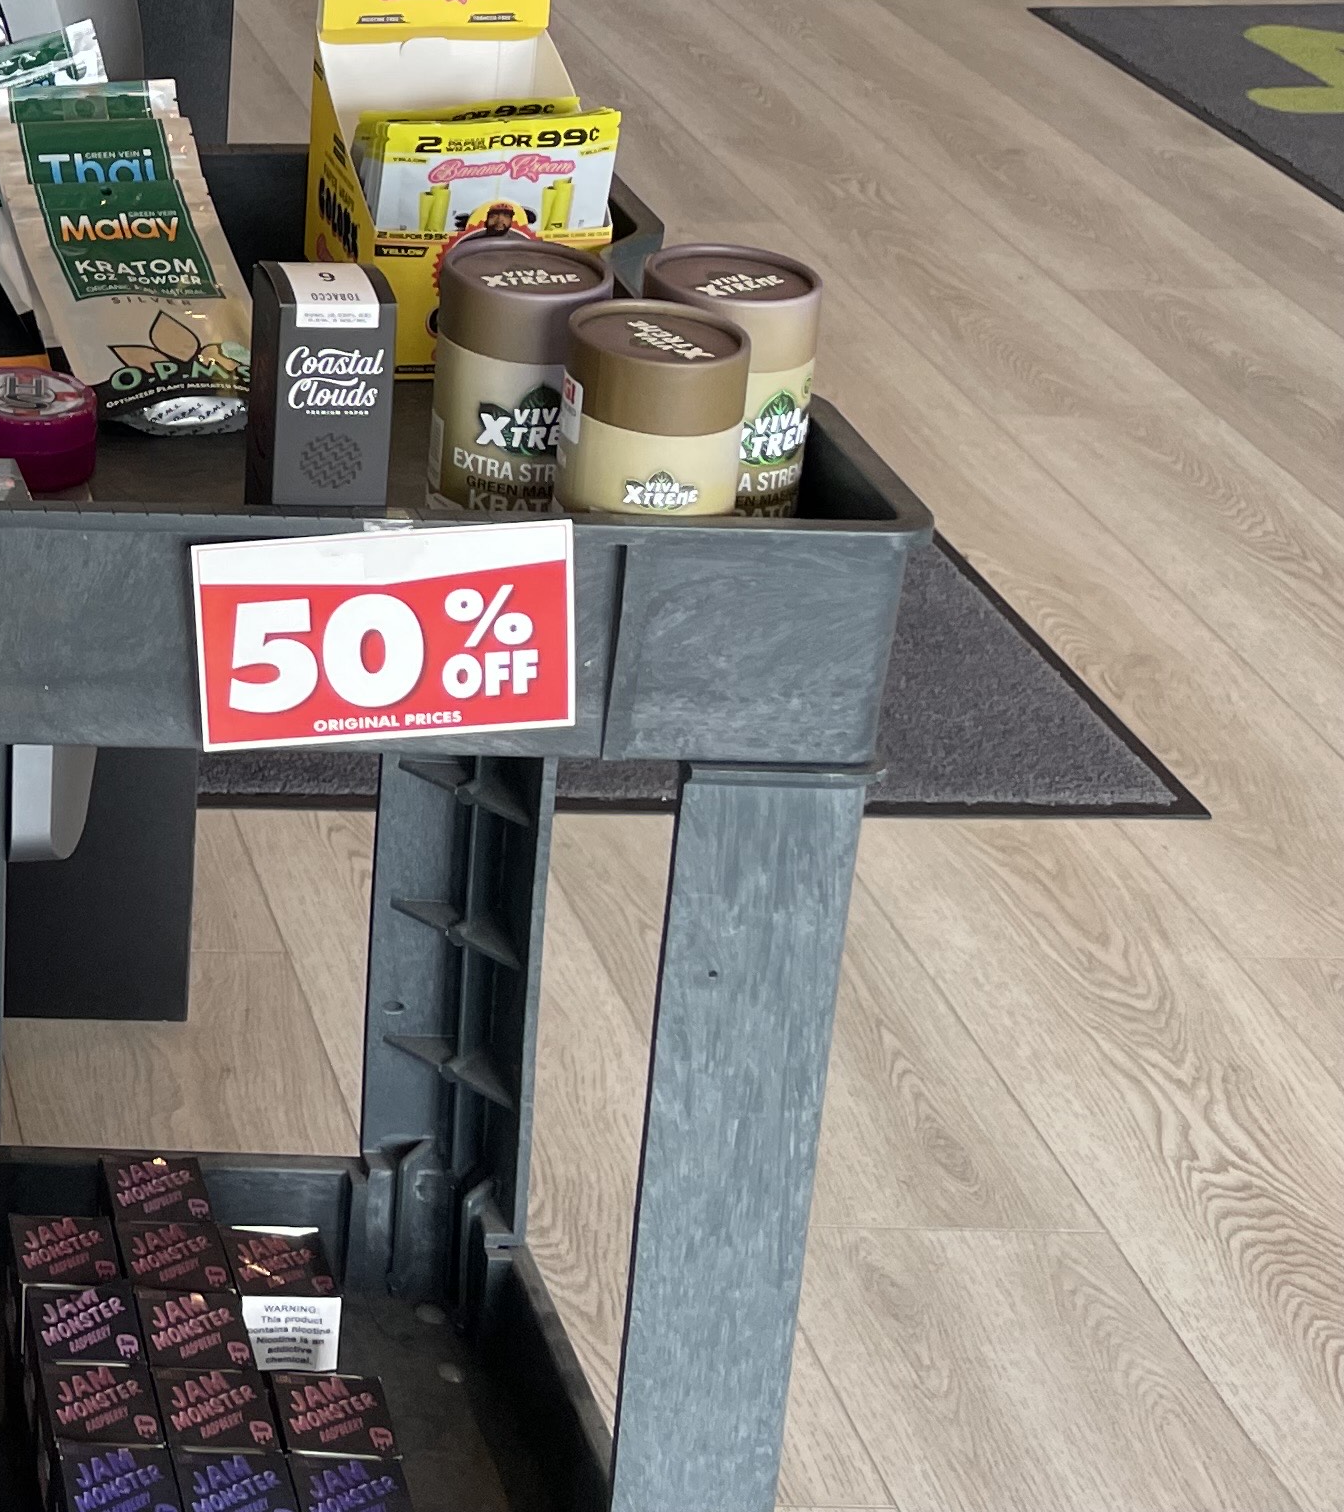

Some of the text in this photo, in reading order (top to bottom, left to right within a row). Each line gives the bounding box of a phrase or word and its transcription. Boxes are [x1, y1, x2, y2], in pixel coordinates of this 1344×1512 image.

[414, 127, 600, 153] 2 FOR 99¢
[428, 153, 576, 183] Banana Cream
[59, 212, 179, 243] Malay
[74, 257, 199, 276] KRATOM
[127, 274, 202, 286] POWDER
[311, 292, 361, 302] TOBACCO
[285, 345, 385, 377] Coastal
[287, 377, 379, 409] Clouds
[453, 446, 514, 481] EXTRA
[622, 482, 698, 506] XTREME
[645, 481, 680, 492] VIVA
[441, 649, 539, 698] OFF
[313, 709, 463, 732] ORIGINAL PRICES
[115, 1169, 194, 1207] MONSTER
[116, 1157, 167, 1189] JAM
